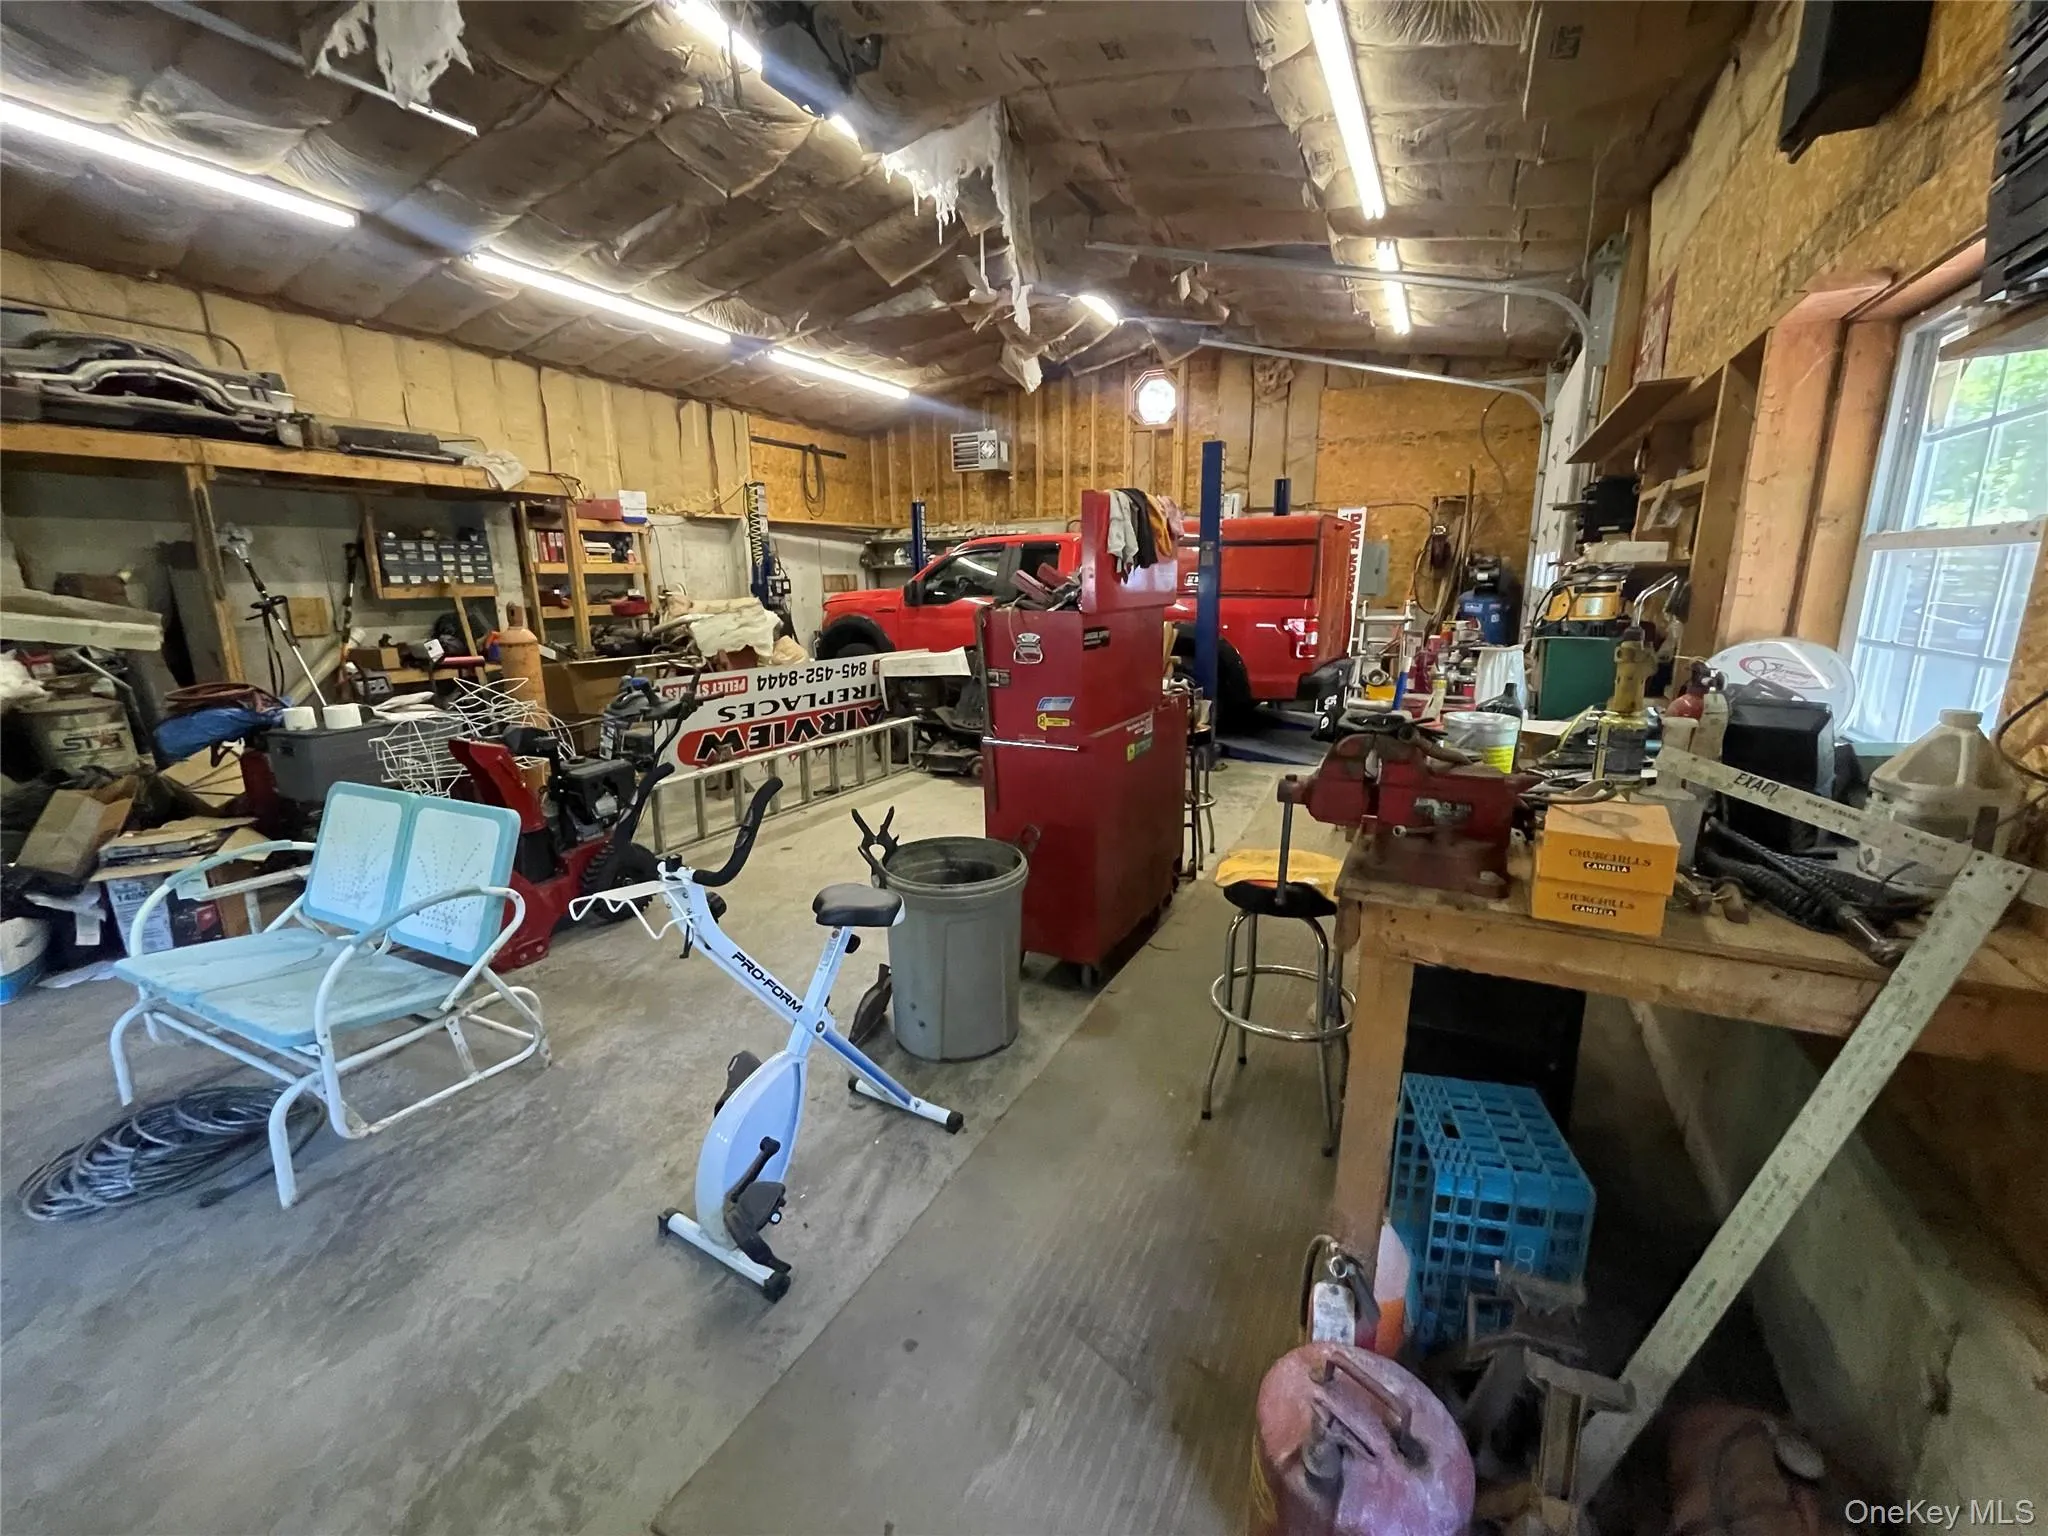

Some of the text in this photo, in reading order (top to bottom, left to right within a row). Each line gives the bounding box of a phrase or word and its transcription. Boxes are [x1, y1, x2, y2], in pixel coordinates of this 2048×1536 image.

[666, 678, 746, 700] PELLET STVES
[757, 661, 867, 691] 845-452-8444
[717, 684, 877, 723] IREPLACES
[694, 703, 885, 761] AIRVIEW
[1586, 861, 1628, 873] CANDELA
[1574, 904, 1615, 917] CANDELA
[732, 952, 803, 1013] PRO-FORM
